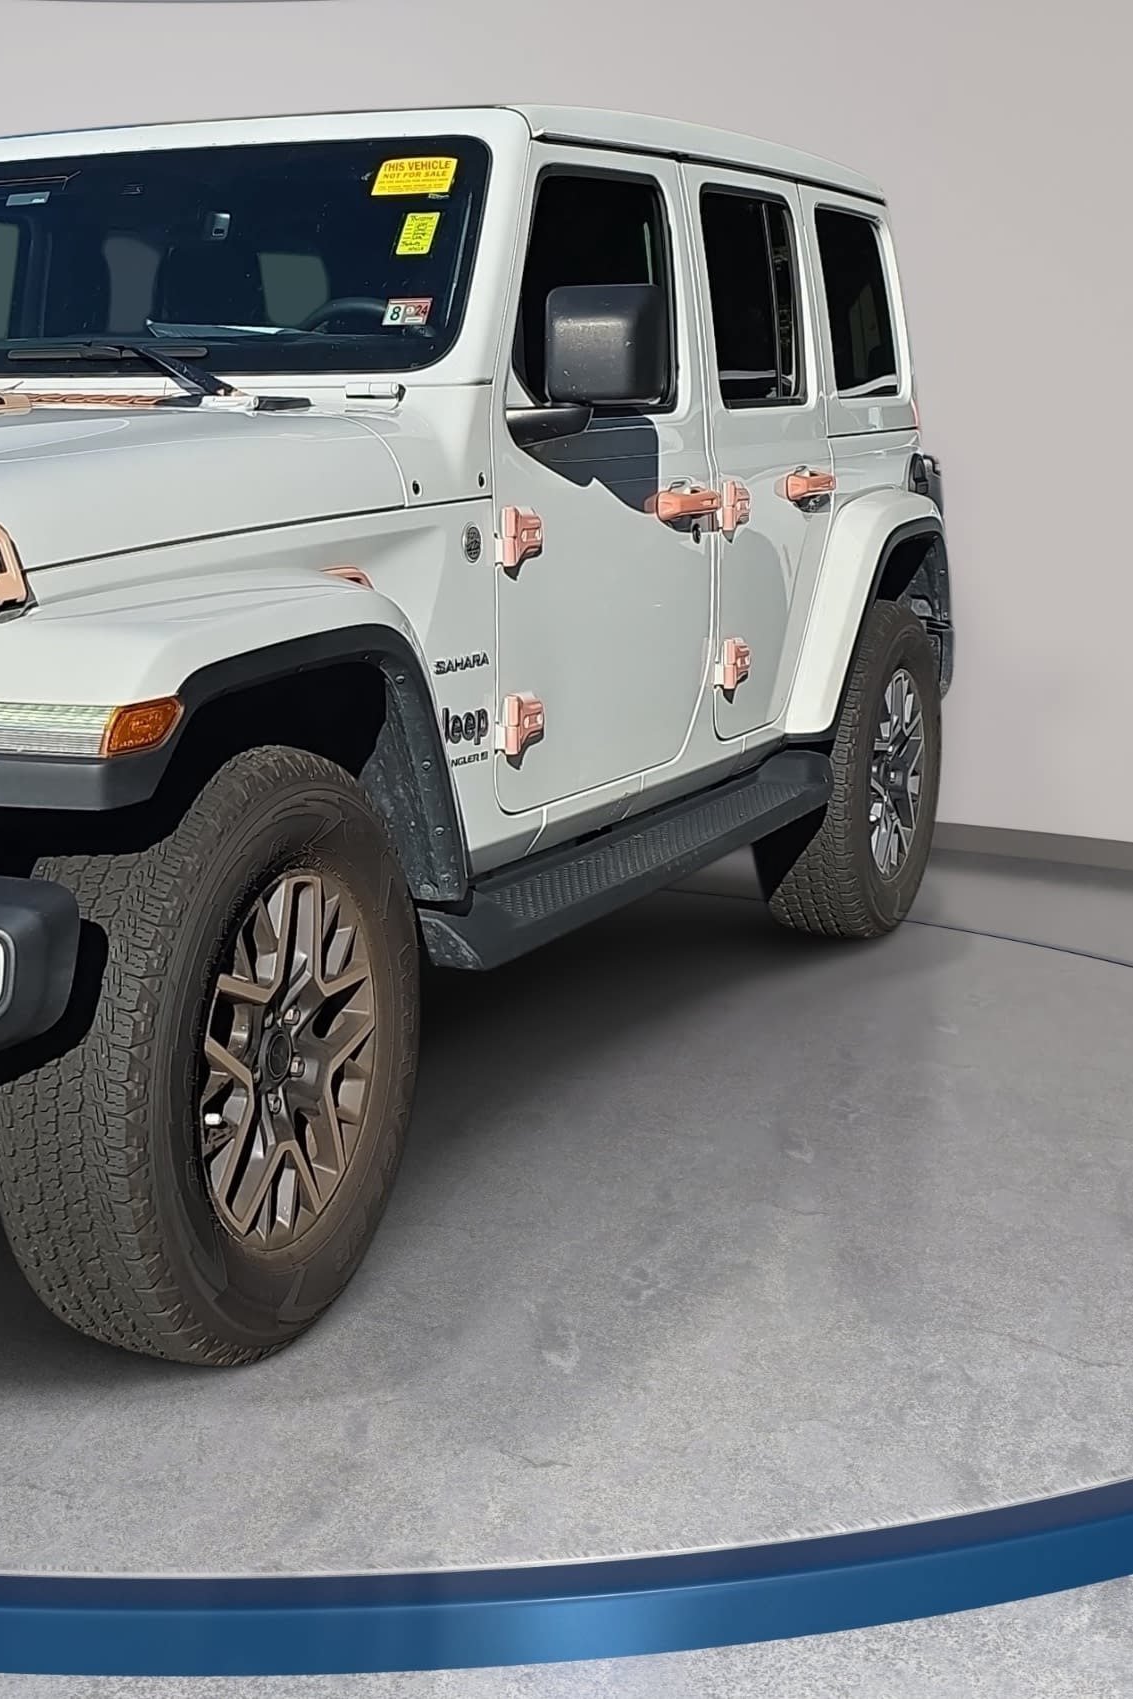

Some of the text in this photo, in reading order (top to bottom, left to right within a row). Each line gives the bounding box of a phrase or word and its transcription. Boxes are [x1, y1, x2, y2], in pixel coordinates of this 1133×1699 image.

[383, 160, 452, 172] THIS VEHICLE
[390, 305, 402, 321] 8
[415, 304, 428, 317] 24
[434, 652, 489, 675] SAHARA
[451, 753, 479, 768] NGLER
